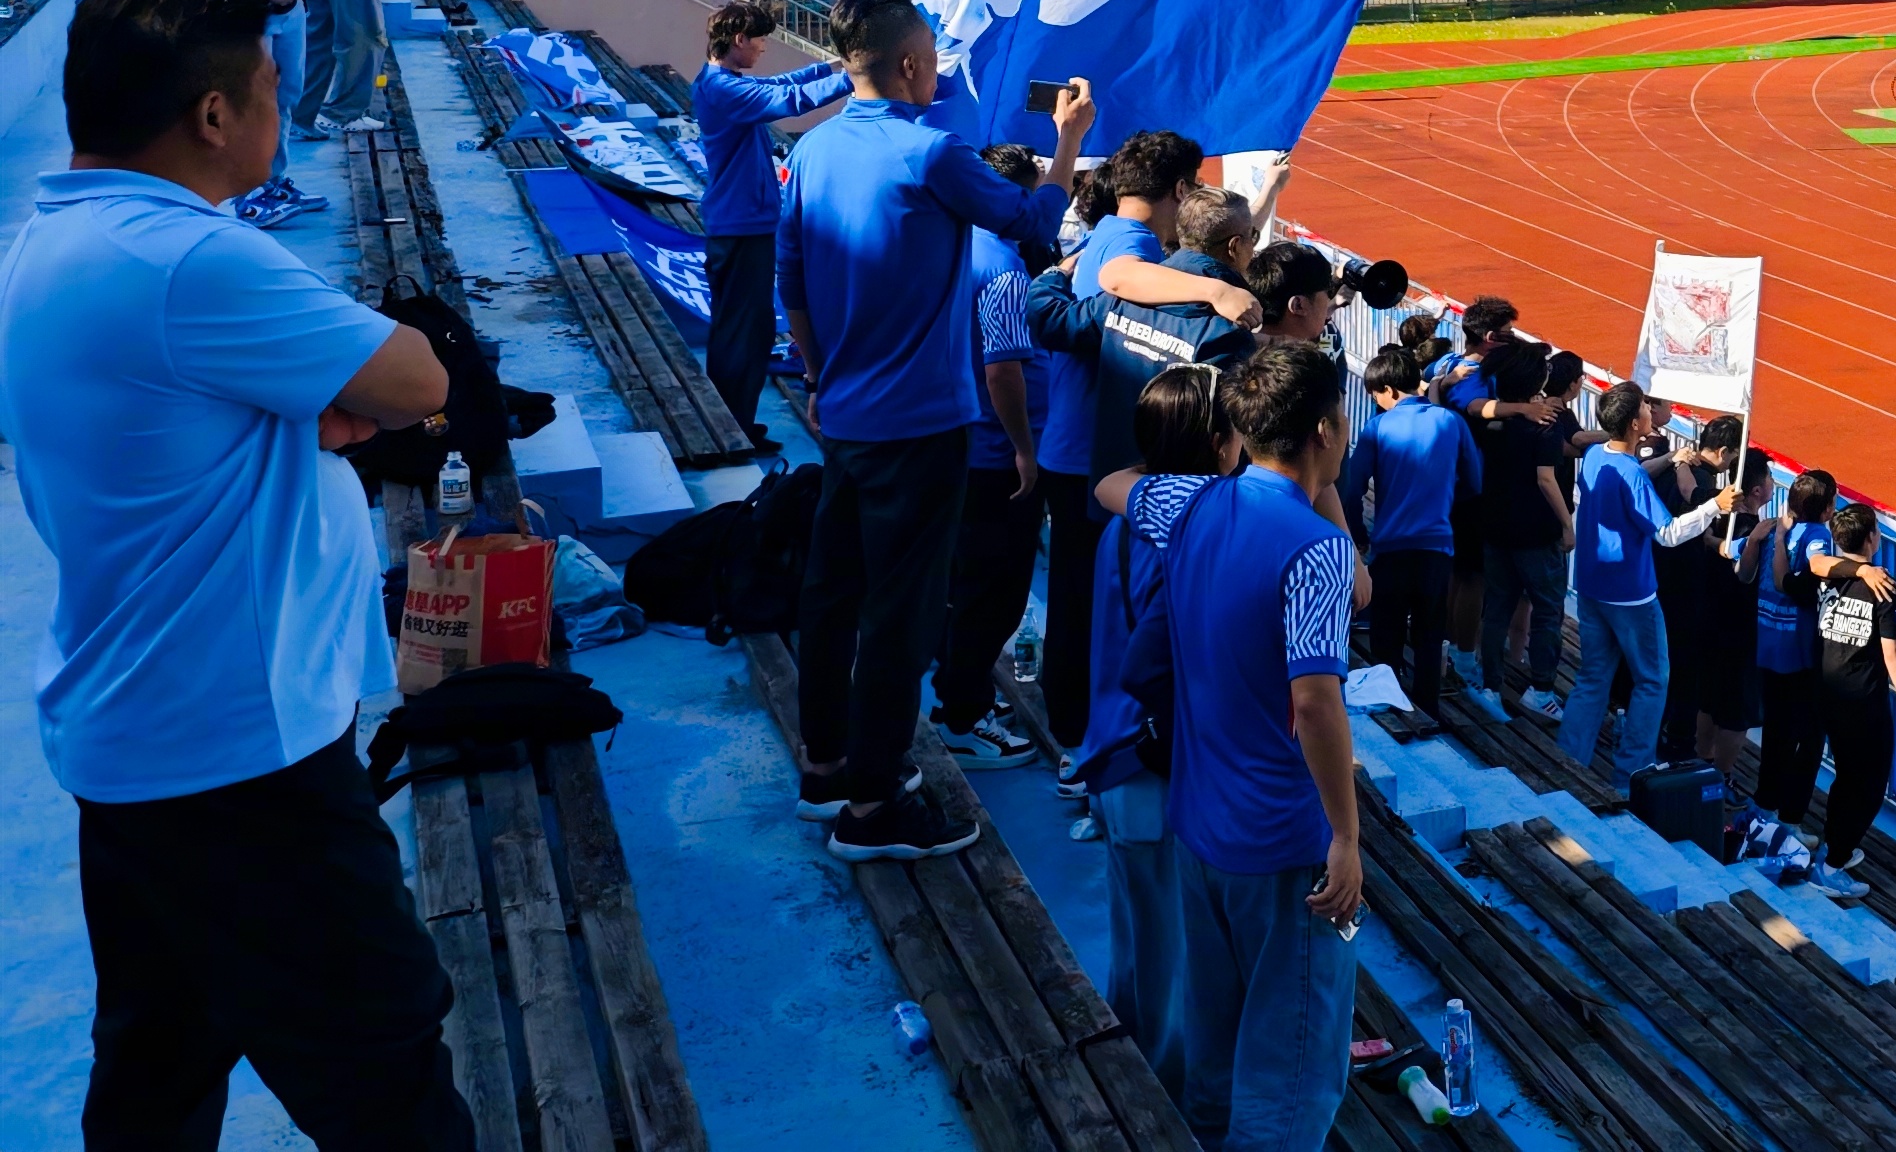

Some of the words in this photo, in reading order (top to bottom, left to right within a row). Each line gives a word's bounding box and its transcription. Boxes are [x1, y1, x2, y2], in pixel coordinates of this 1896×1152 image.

[498, 595, 537, 620] KFC
[1836, 596, 1874, 621] CURVA
[1832, 613, 1873, 638] RANGERS
[1832, 632, 1851, 645] WHAT
